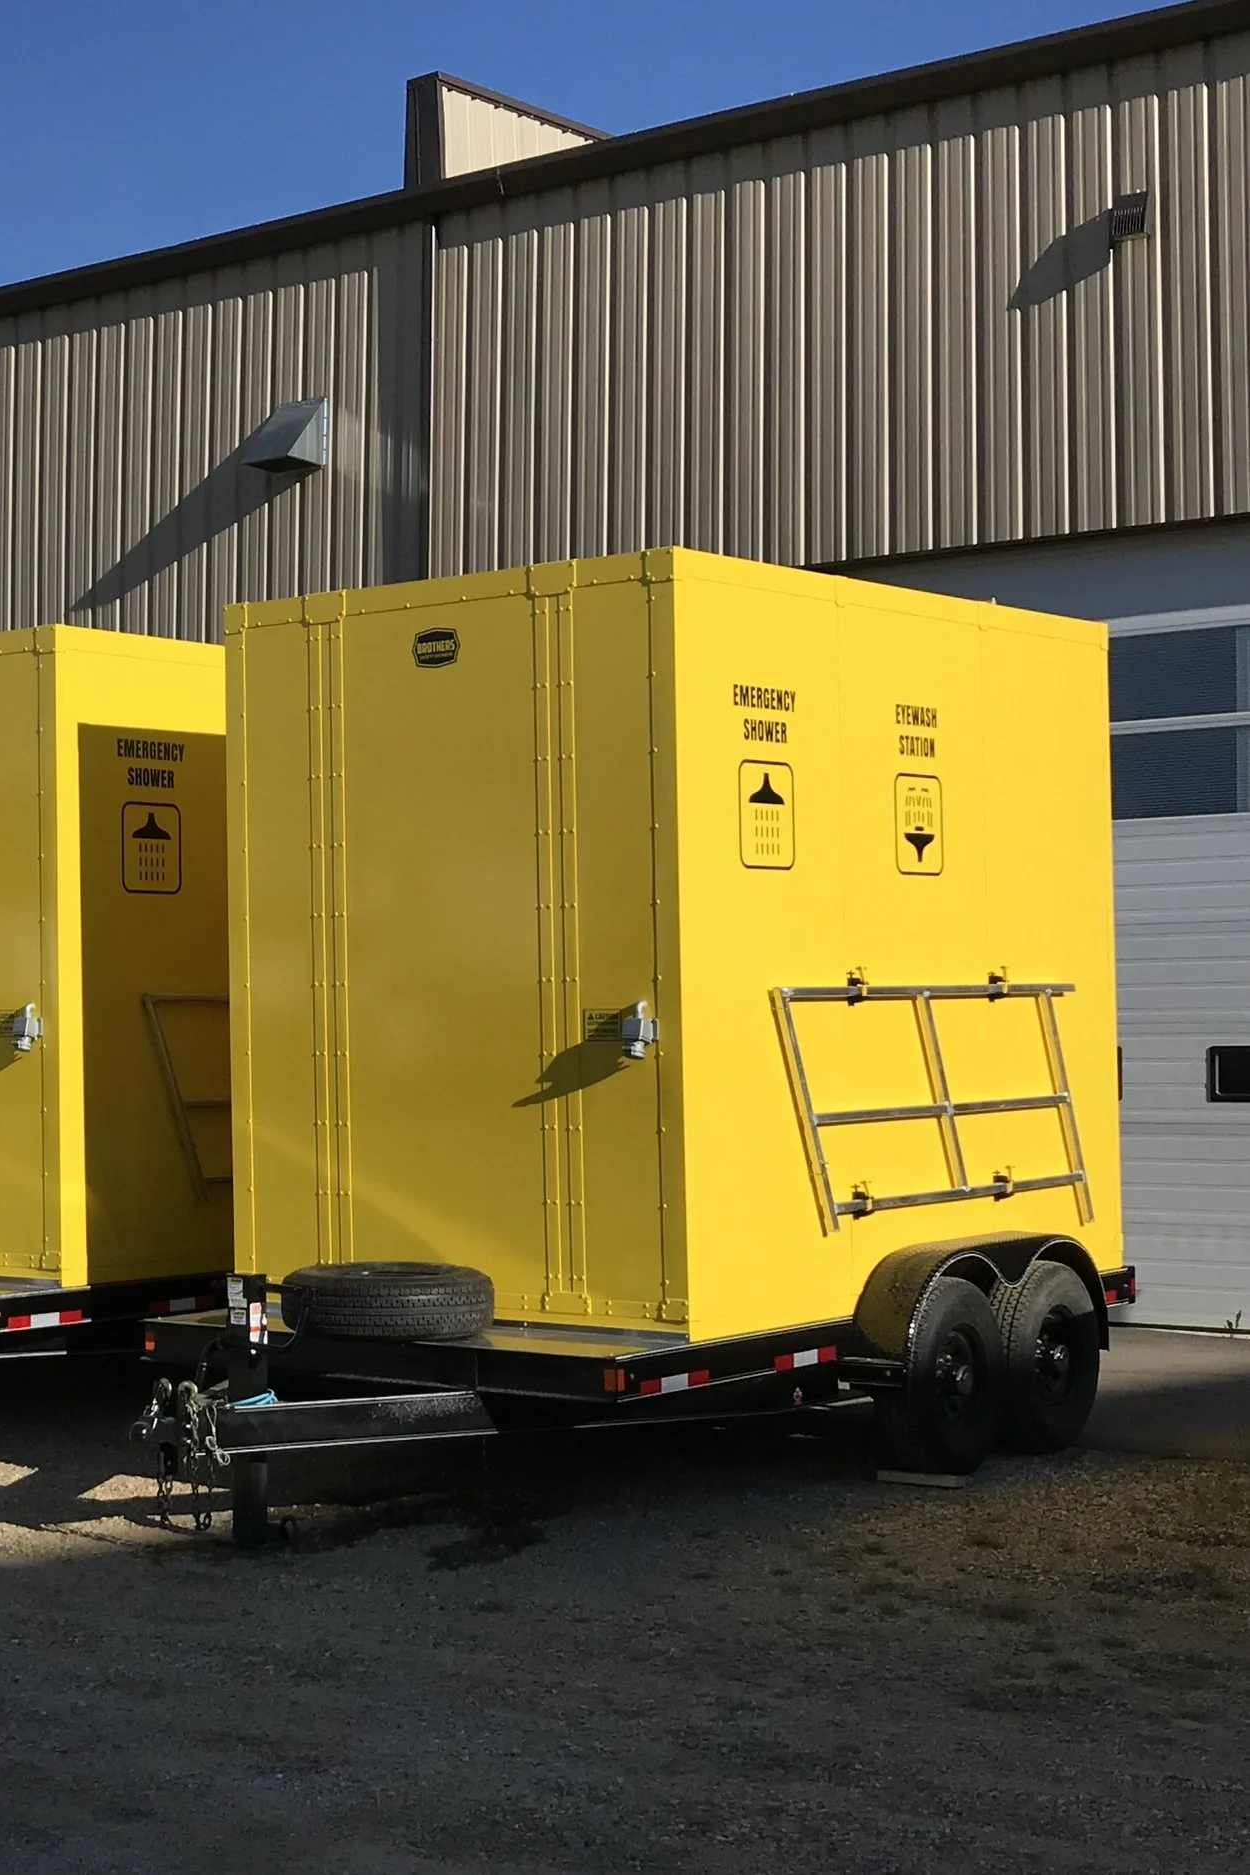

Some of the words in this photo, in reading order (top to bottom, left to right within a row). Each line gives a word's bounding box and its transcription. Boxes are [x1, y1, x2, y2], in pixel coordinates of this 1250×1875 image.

[417, 639, 455, 655] BROTHERS
[733, 684, 796, 712] EMERGENCY
[895, 703, 937, 728] EYEWASH
[743, 718, 787, 744] SHOWER
[117, 738, 184, 762] EMERGENCY
[899, 734, 935, 758] STATION
[127, 766, 174, 788] SHOWER
